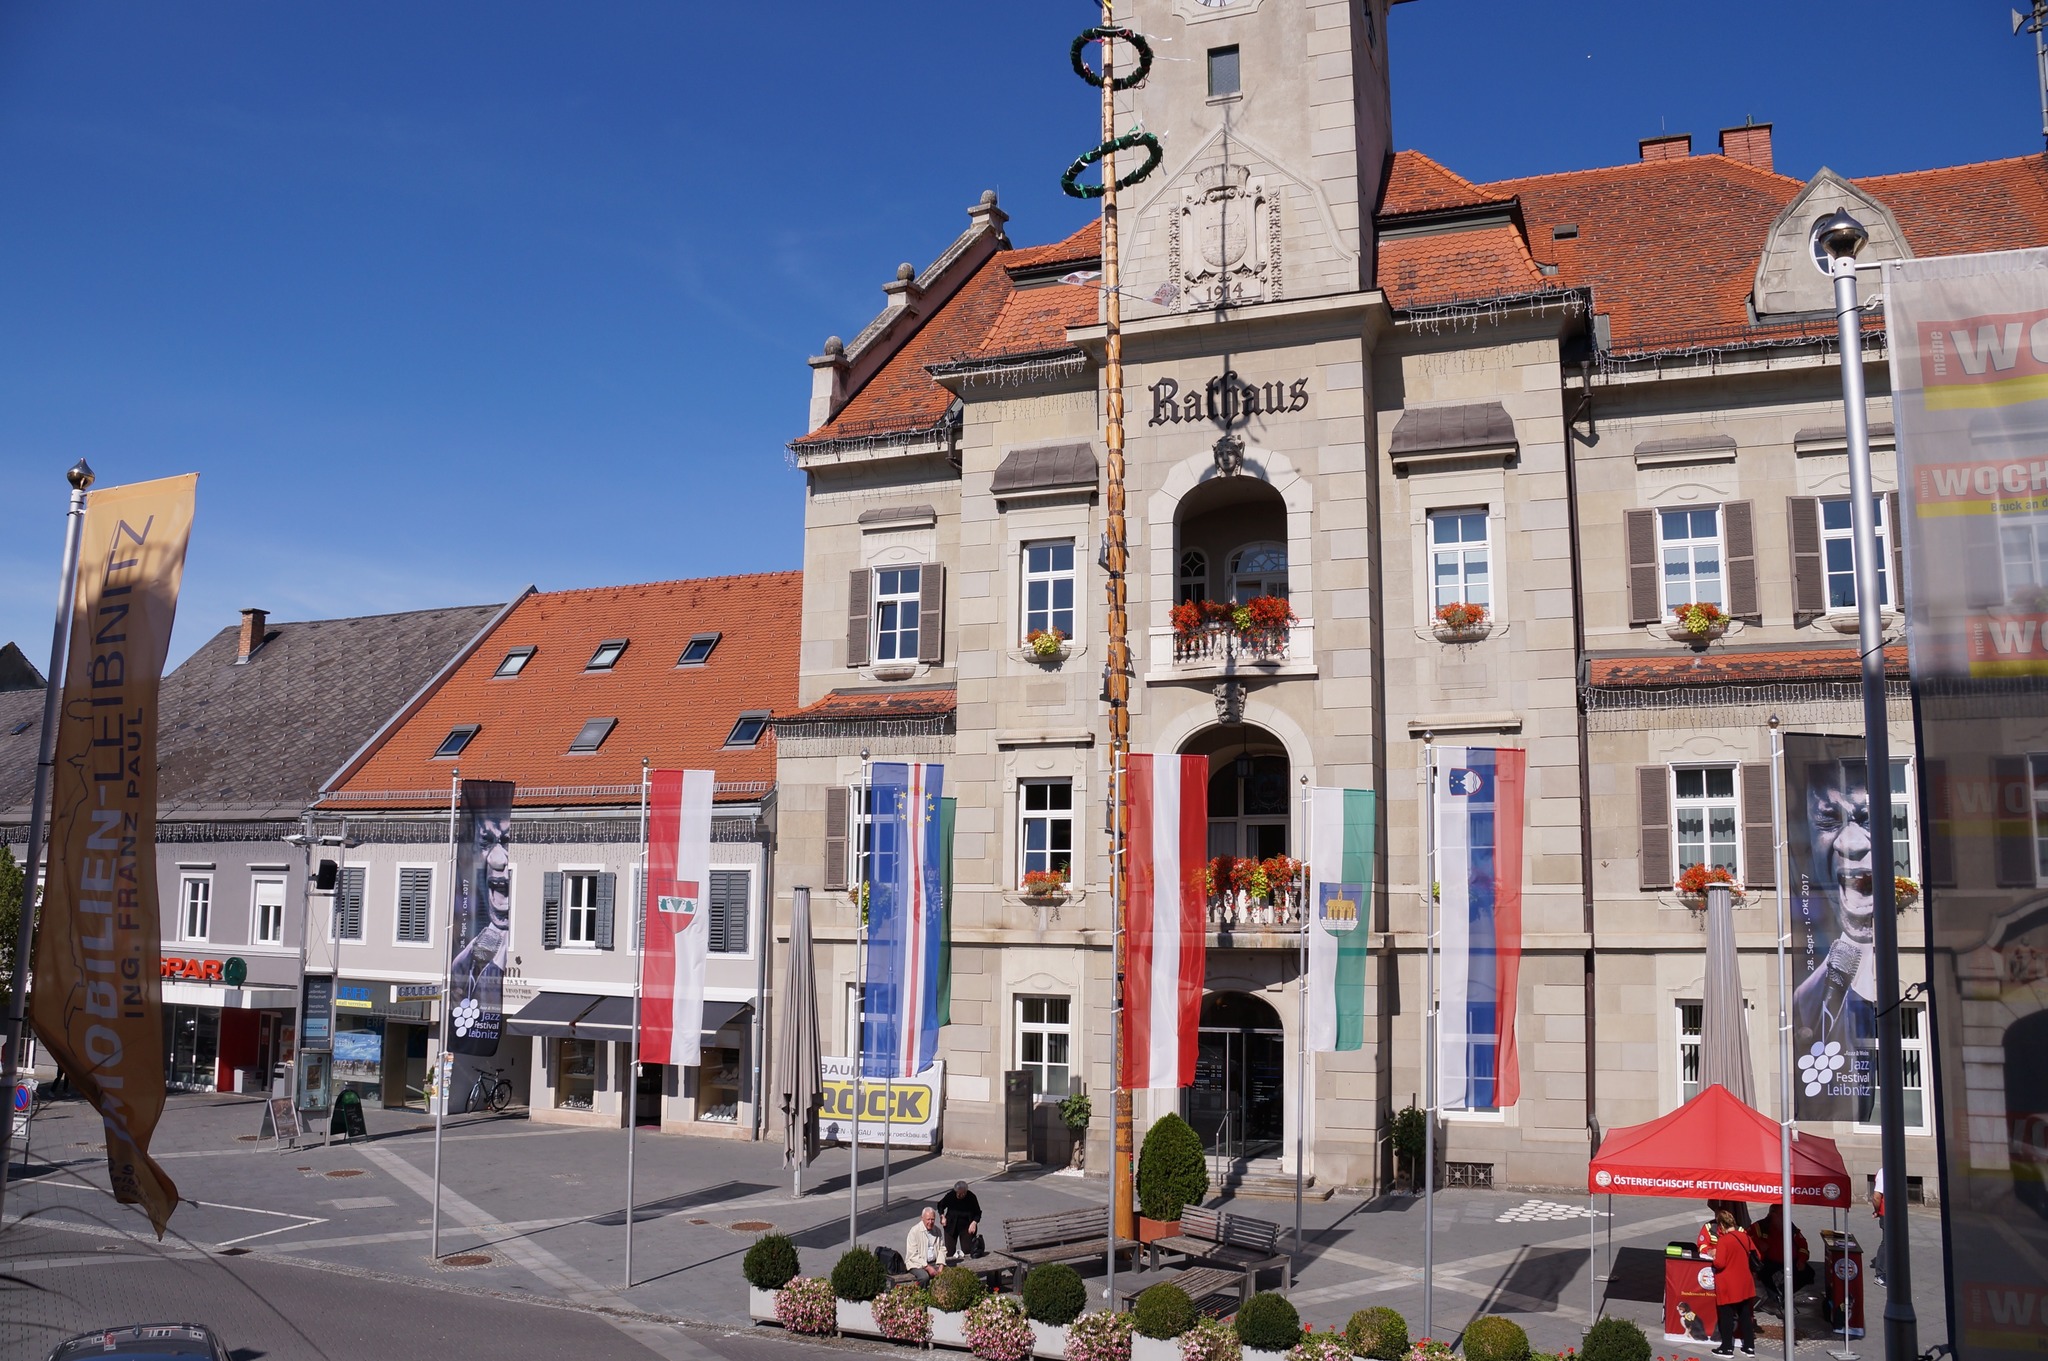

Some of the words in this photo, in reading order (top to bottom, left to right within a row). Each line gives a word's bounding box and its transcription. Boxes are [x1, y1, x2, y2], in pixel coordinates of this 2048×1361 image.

[1207, 282, 1244, 302] 1914
[1930, 331, 1947, 376] meine
[1147, 370, 1309, 430] Rathaus
[1920, 470, 1929, 498] meine
[1990, 500, 2022, 512] Bruck
[2026, 500, 2039, 510] an
[1975, 623, 1984, 656] meine
[126, 707, 143, 799] PAUL
[118, 811, 140, 930] FRANZ
[1801, 873, 1809, 896] 2017
[1806, 934, 1815, 955] Sept
[1807, 957, 1815, 971] 28.
[120, 946, 145, 1018] ING.
[481, 1011, 500, 1022] Jazz
[1849, 1058, 1870, 1073] Jazz
[1836, 1072, 1870, 1083] Festival
[1827, 1084, 1871, 1096] Leibnitz
[1613, 1174, 1694, 1188] ÖSTERREICHISCHE
[1696, 1180, 1821, 1196] RETTUNGSHUNDEBIGADE
